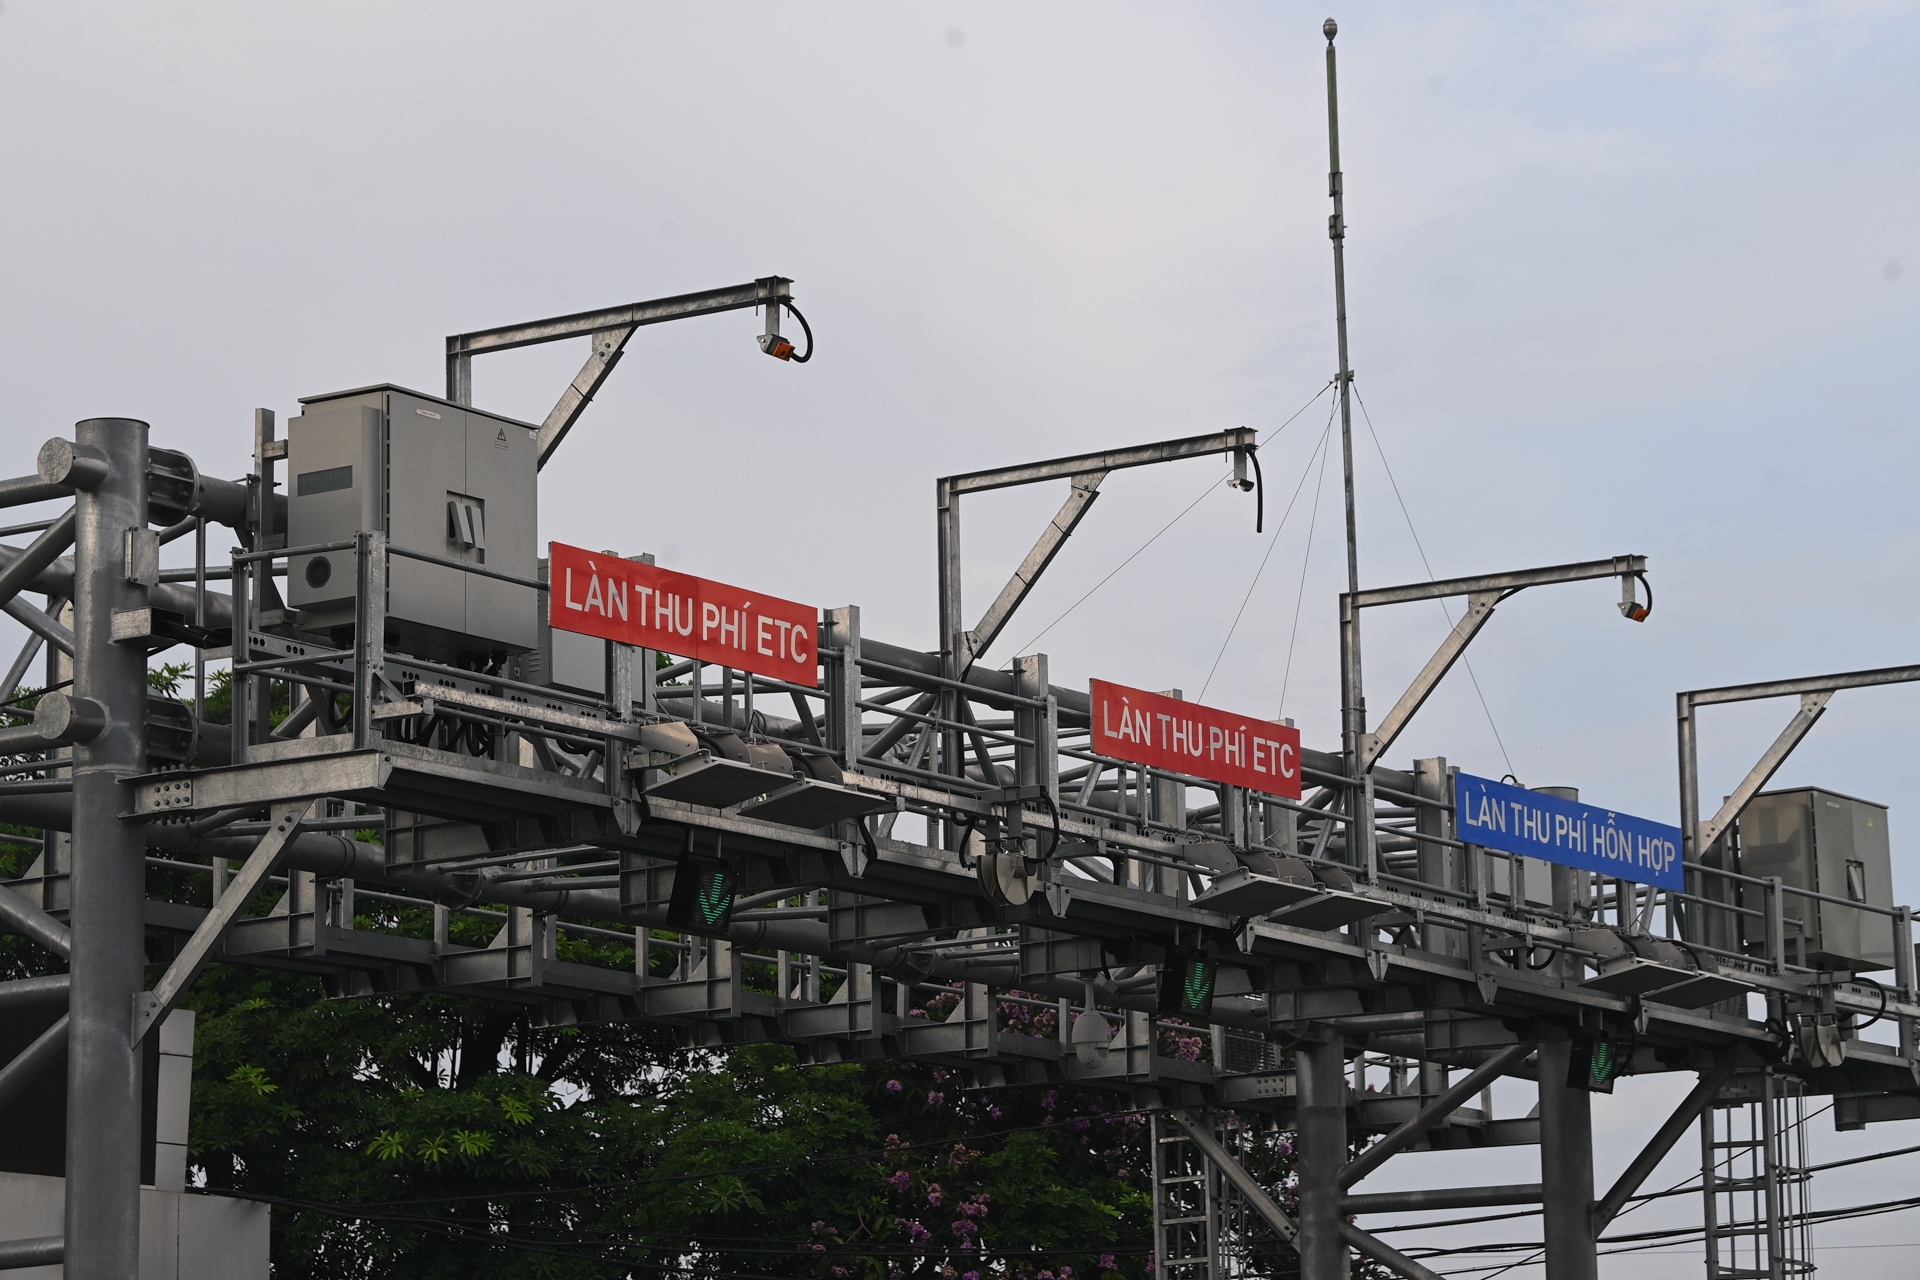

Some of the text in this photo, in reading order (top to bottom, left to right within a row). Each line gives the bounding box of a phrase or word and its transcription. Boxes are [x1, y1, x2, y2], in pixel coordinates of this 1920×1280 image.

[565, 560, 809, 664] LÀN THU PHÍ ETC
[1103, 696, 1294, 779] LÀN THU PHÍ ETC
[1465, 783, 1676, 877] LÀN THU PHÍ HỖN HỢP
